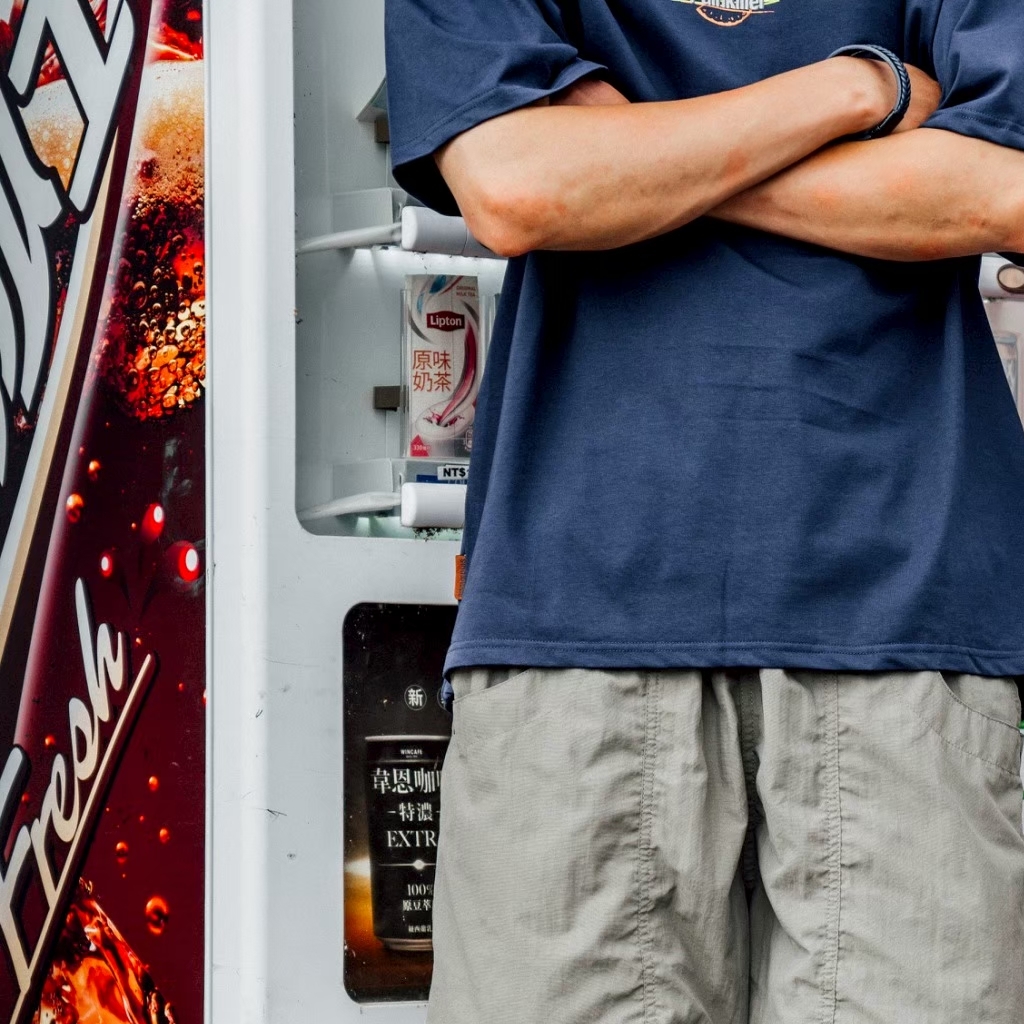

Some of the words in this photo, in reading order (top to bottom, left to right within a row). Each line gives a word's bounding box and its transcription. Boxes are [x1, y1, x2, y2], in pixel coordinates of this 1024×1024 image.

[430, 315, 462, 327] Lipton
[413, 350, 451, 370] 原味
[413, 371, 452, 392] 奶茶
[443, 467, 469, 478] NT$
[407, 688, 424, 707] 新
[371, 768, 440, 794] 韋恩咖
[399, 802, 433, 821] 特濃
[387, 830, 437, 847] EXTR
